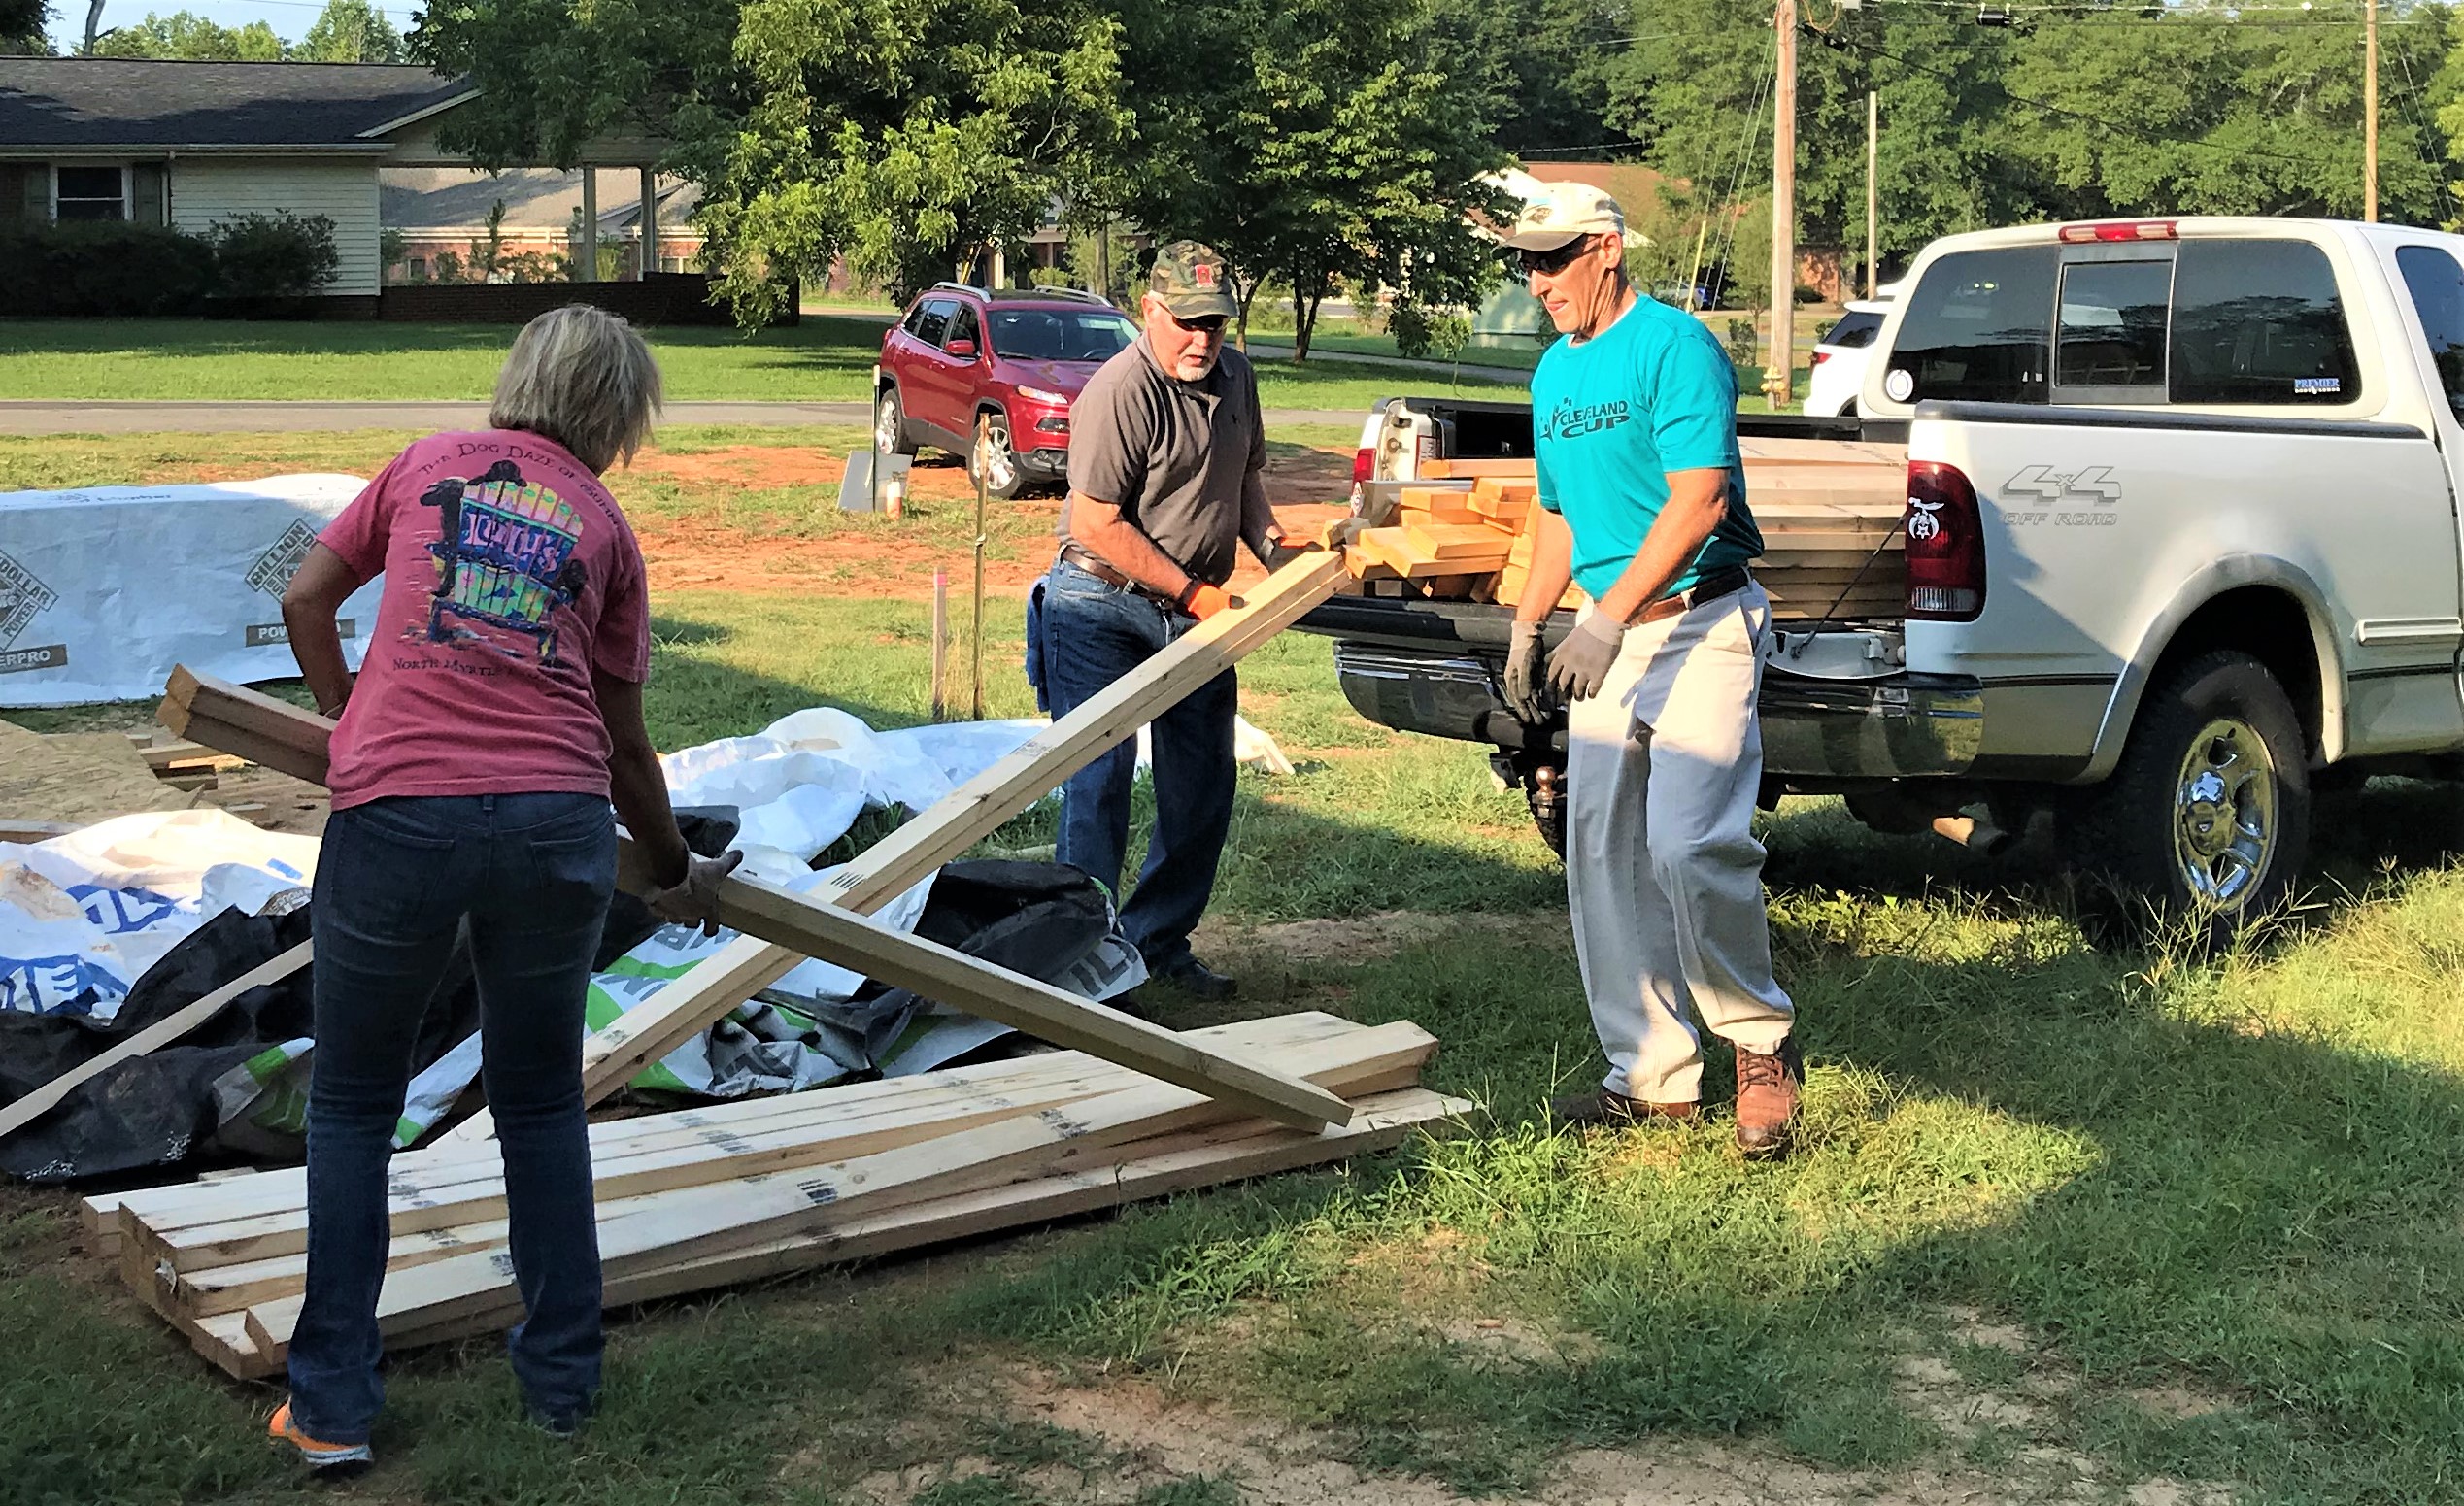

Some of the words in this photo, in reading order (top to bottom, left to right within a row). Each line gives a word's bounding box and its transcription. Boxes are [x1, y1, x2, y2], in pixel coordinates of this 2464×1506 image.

[2294, 378, 2340, 388] PREMIER
[1559, 400, 1629, 426] CLEVELAND
[1561, 415, 1631, 439] CUP
[2004, 512, 2049, 526] OFF
[2054, 512, 2118, 526] ROAD
[251, 525, 308, 586] BILLION
[0, 558, 51, 605] DOLLAR
[267, 578, 288, 596] BUY
[0, 650, 51, 666] ERPRO
[393, 658, 439, 671] NORTH
